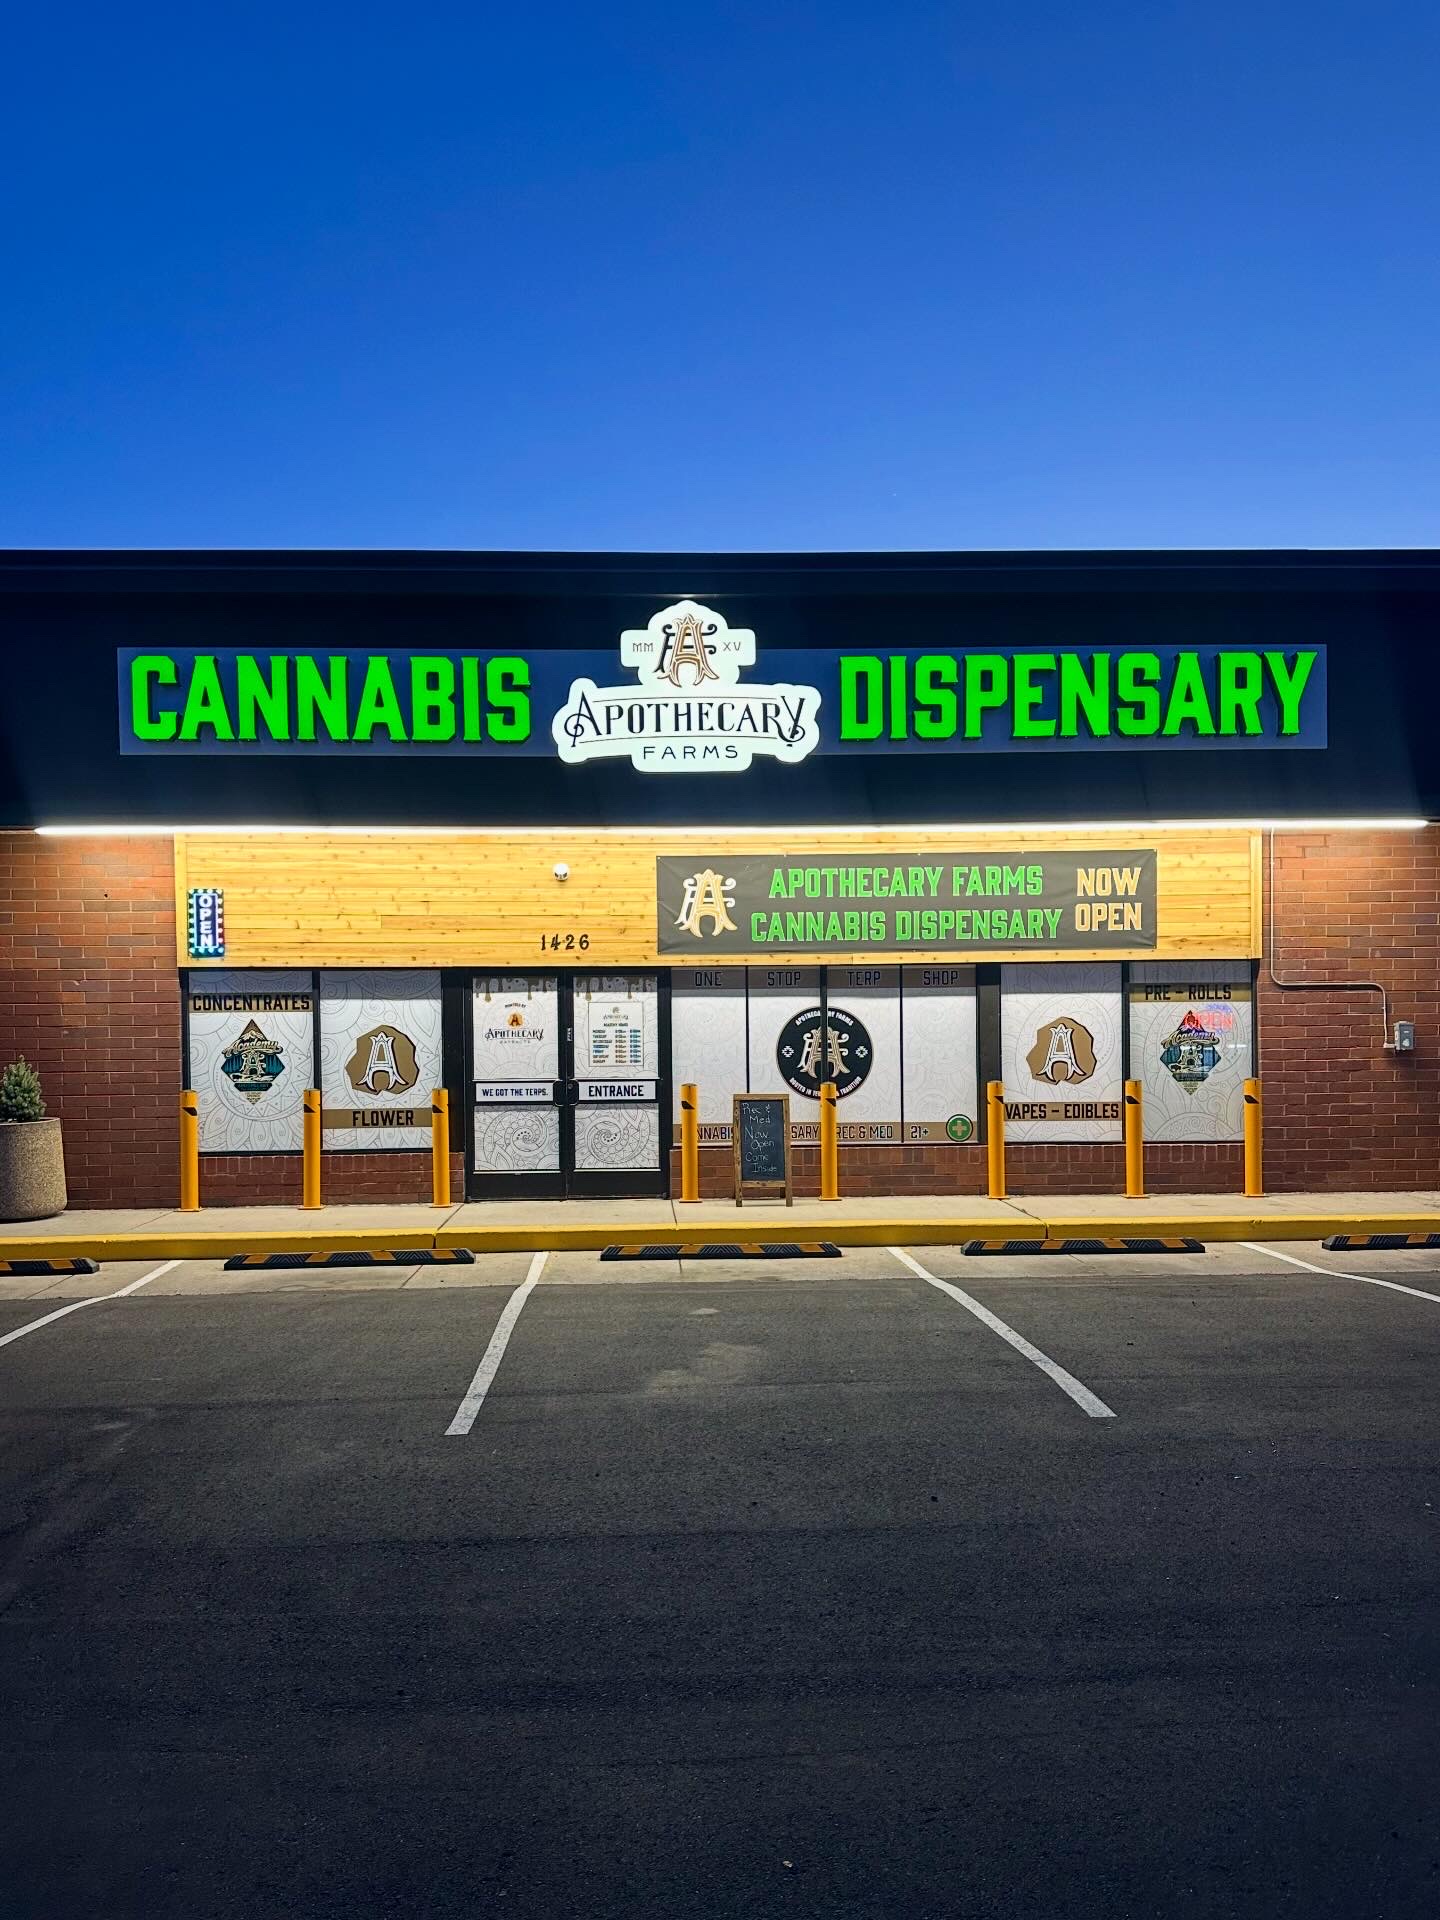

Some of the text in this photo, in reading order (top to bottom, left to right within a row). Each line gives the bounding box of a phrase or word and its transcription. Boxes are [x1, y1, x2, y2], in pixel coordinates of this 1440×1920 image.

[632, 641, 742, 653] MM XV
[131, 655, 531, 742] CANNABIS
[839, 651, 1318, 739] DISPENSARY
[564, 691, 806, 748] APOTHECARY
[643, 745, 739, 760] FARMS
[768, 865, 1043, 899] APOTHECARY FARMS
[1076, 866, 1142, 897] NOW
[198, 895, 213, 947] OPEN
[750, 908, 1063, 943] CANNABIS DISPENSARY
[1074, 902, 1143, 932] OPEN
[541, 933, 590, 951] 1426
[695, 971, 722, 987] ONE
[767, 971, 800, 986] STOP
[847, 970, 881, 986] TERP
[923, 970, 959, 985] SHOP
[1145, 984, 1171, 1000] PRE
[1188, 984, 1232, 1000] ROLLS
[193, 994, 310, 1011] CONCENTRATES
[482, 1088, 494, 1097] WE
[495, 1088, 508, 1097] GOT
[510, 1088, 524, 1096] THE
[588, 1085, 645, 1097] ENTRANCE
[352, 1110, 414, 1127] FLOWER
[1005, 1103, 1047, 1120] VAPES
[1064, 1103, 1119, 1119] EDIBLES
[858, 1125, 866, 1139] &
[869, 1125, 893, 1139] MED
[910, 1125, 929, 1139] 21+
